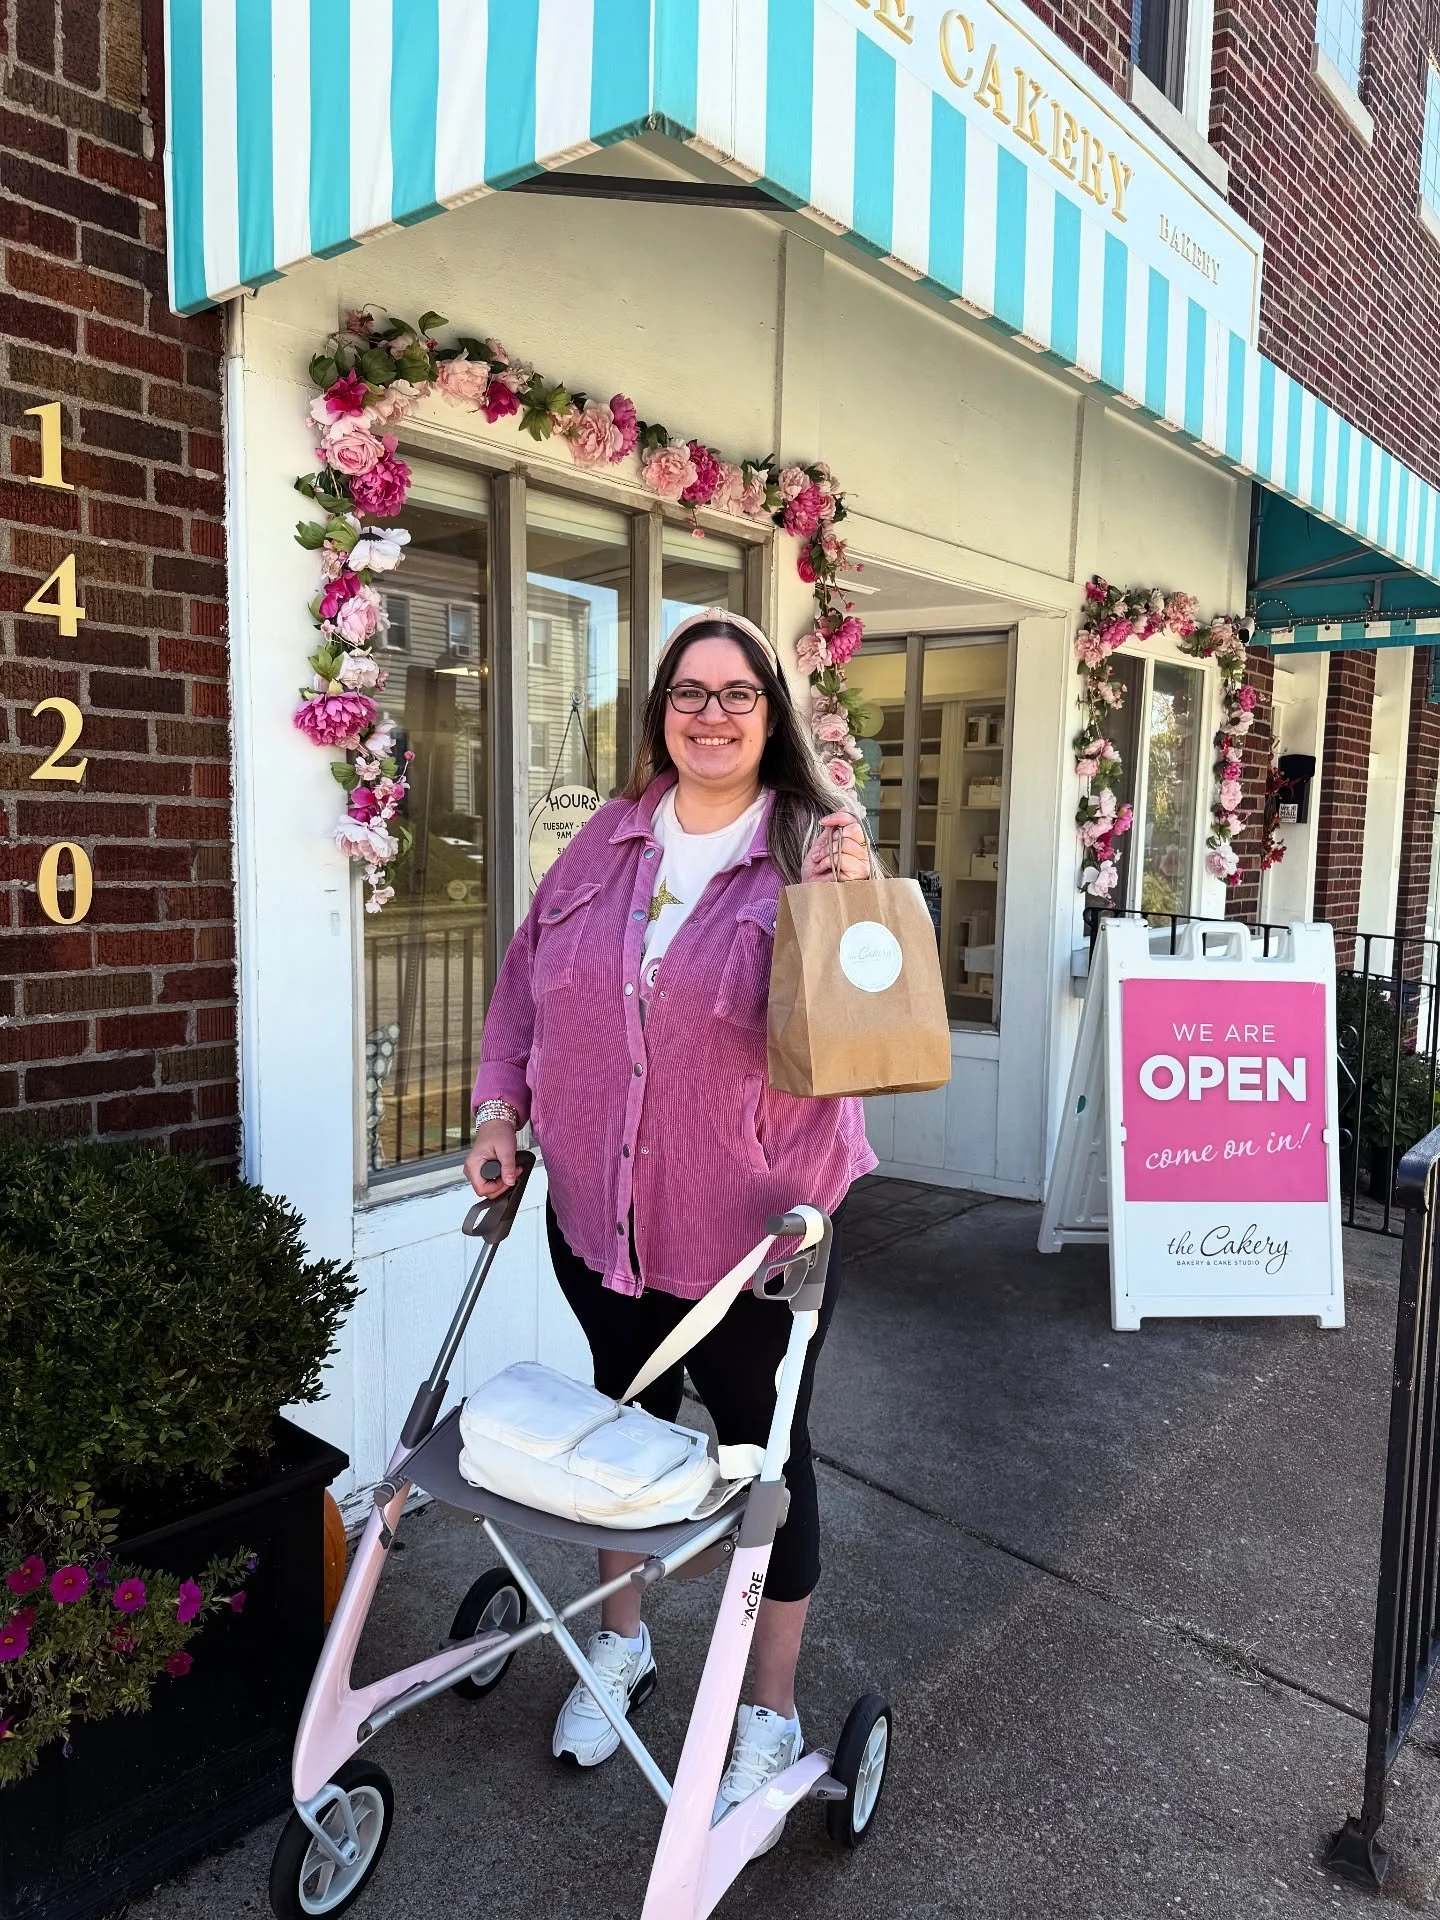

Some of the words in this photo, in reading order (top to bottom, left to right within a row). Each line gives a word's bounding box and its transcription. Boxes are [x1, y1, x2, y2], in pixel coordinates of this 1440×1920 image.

[939, 8, 1135, 223] CAKERY
[1159, 213, 1220, 286] BAKERY
[543, 822, 574, 830] TUESDAY
[549, 794, 597, 811] HOURS
[1172, 1022, 1215, 1043] WE
[1224, 1023, 1277, 1044] ARE
[1139, 1054, 1307, 1102] OPEN
[1145, 1143, 1219, 1170] come
[1223, 1138, 1261, 1161] on
[1266, 1122, 1312, 1155] in!
[1166, 1230, 1196, 1255] the
[1199, 1222, 1291, 1276] Cakery
